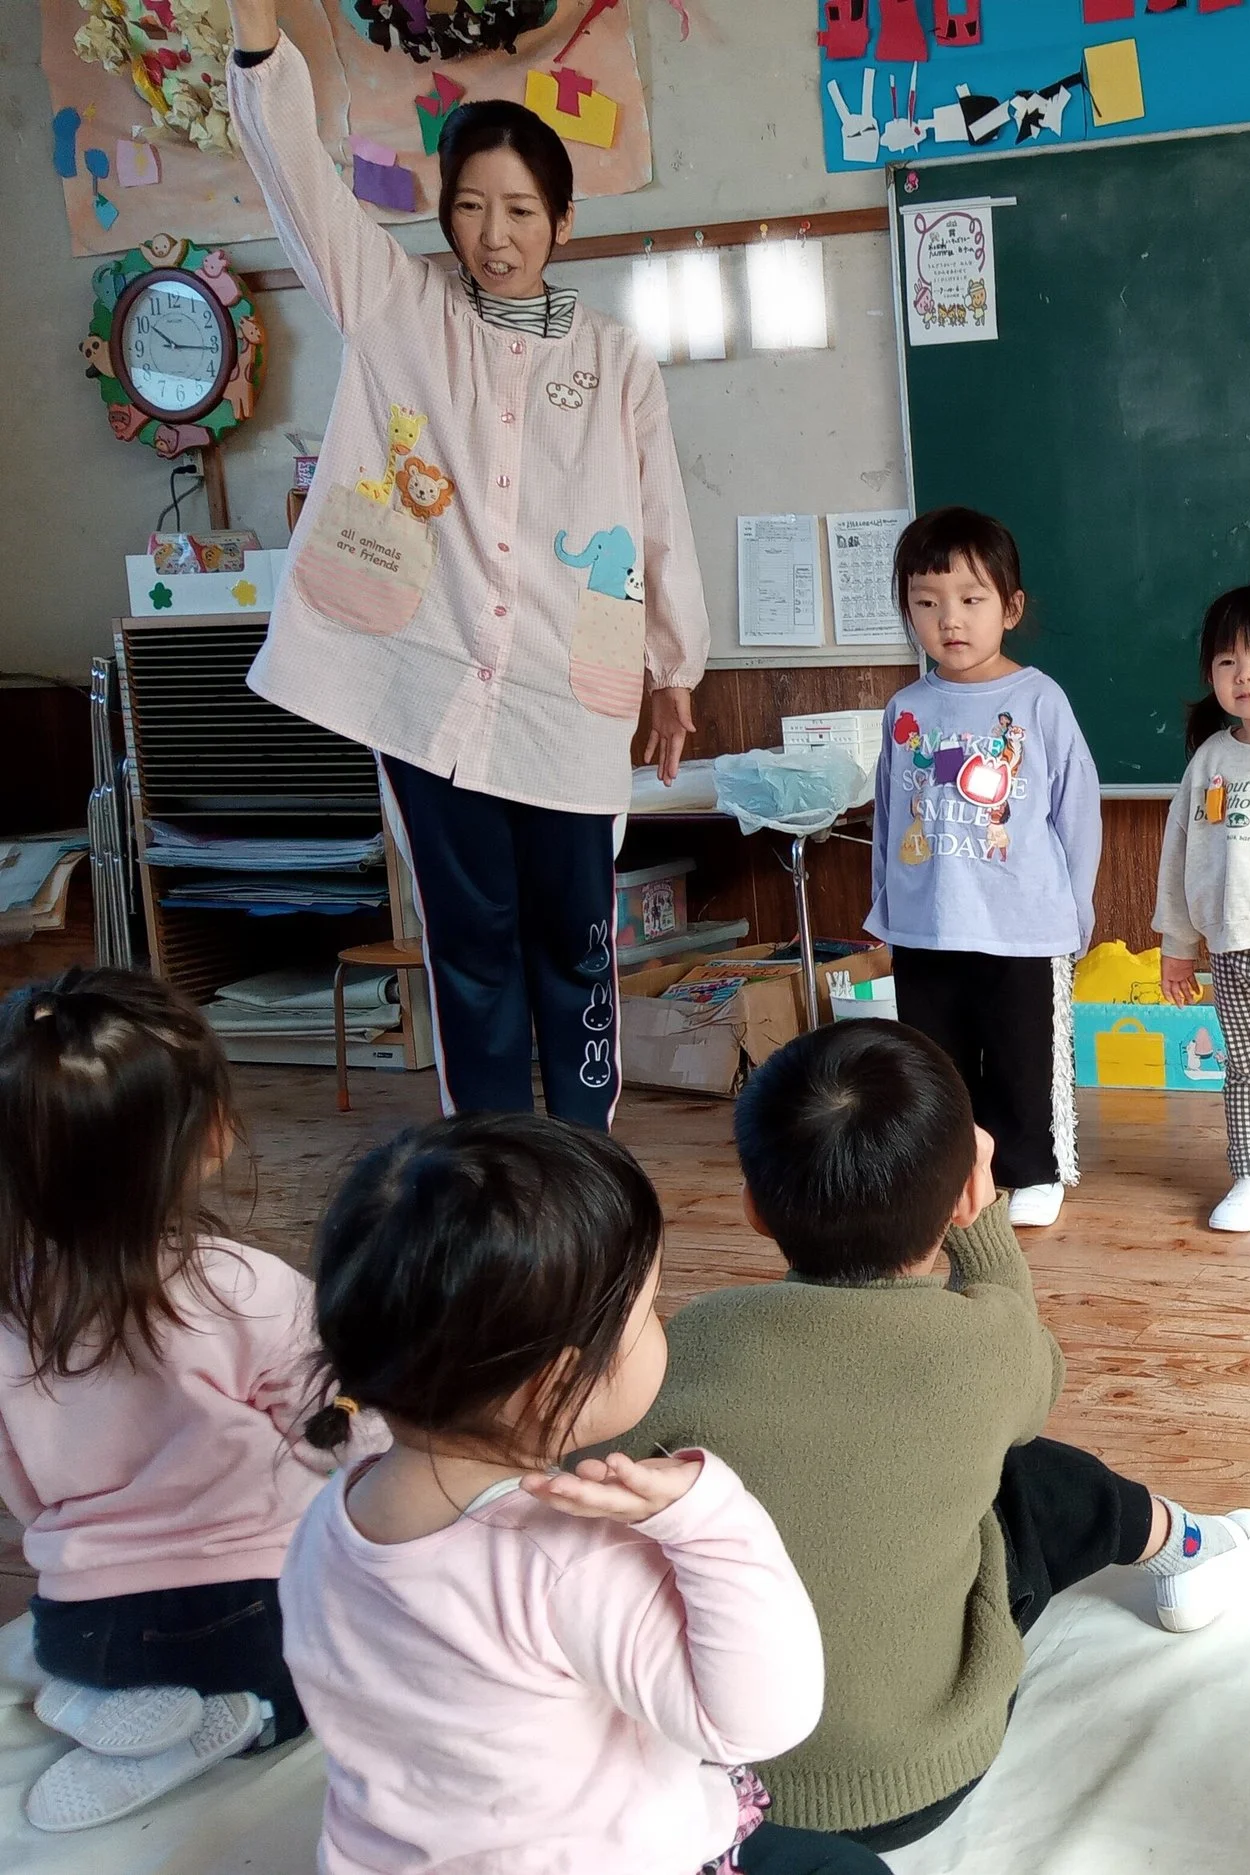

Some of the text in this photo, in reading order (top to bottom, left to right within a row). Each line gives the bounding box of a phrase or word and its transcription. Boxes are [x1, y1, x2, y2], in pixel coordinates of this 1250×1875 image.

[150, 297, 161, 316] 11
[168, 292, 181, 309] 12
[136, 316, 150, 334] 10
[203, 311, 212, 329] 2
[135, 341, 144, 358] 9
[210, 336, 219, 354] 3
[206, 360, 216, 378] 4
[157, 380, 167, 398] 7
[176, 384, 186, 402] 6
[341, 528, 402, 560] all animals
[336, 540, 400, 573] are friends
[911, 833, 996, 862] TODAY
